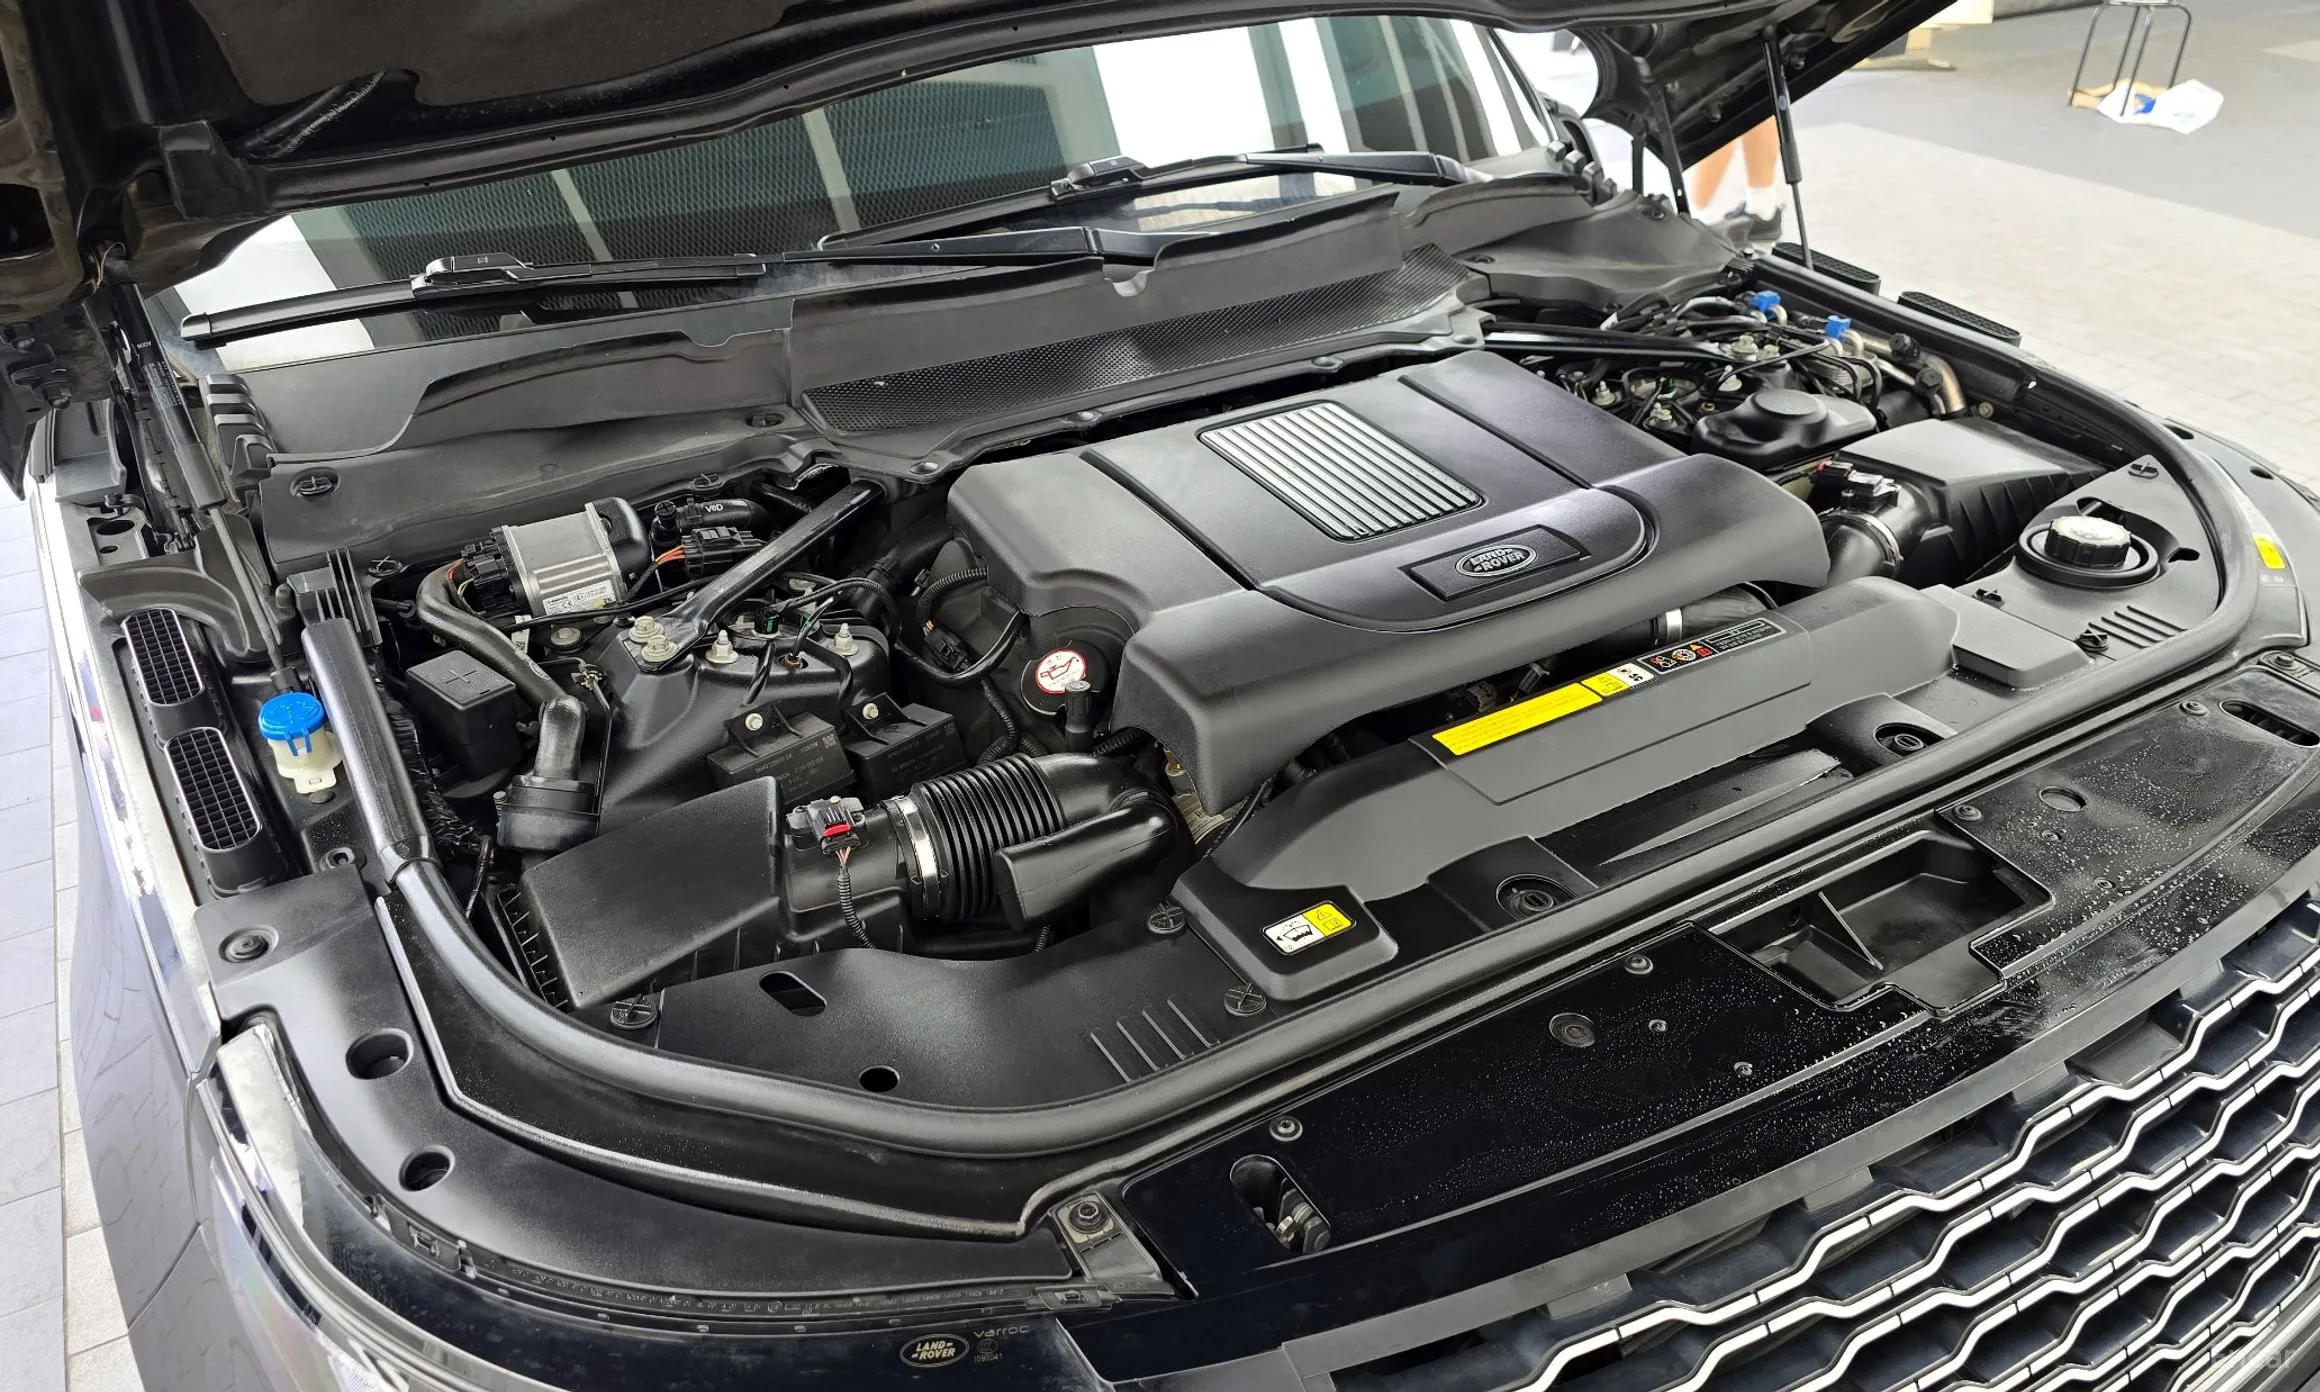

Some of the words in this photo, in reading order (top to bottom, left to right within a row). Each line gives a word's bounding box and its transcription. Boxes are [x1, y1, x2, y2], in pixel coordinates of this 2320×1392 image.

[1470, 548, 1508, 566] LAND
[1480, 551, 1526, 571] ROVER
[973, 1325, 1030, 1338] varroc
[915, 1340, 947, 1352] LAND
[918, 1347, 956, 1360] ROVER
